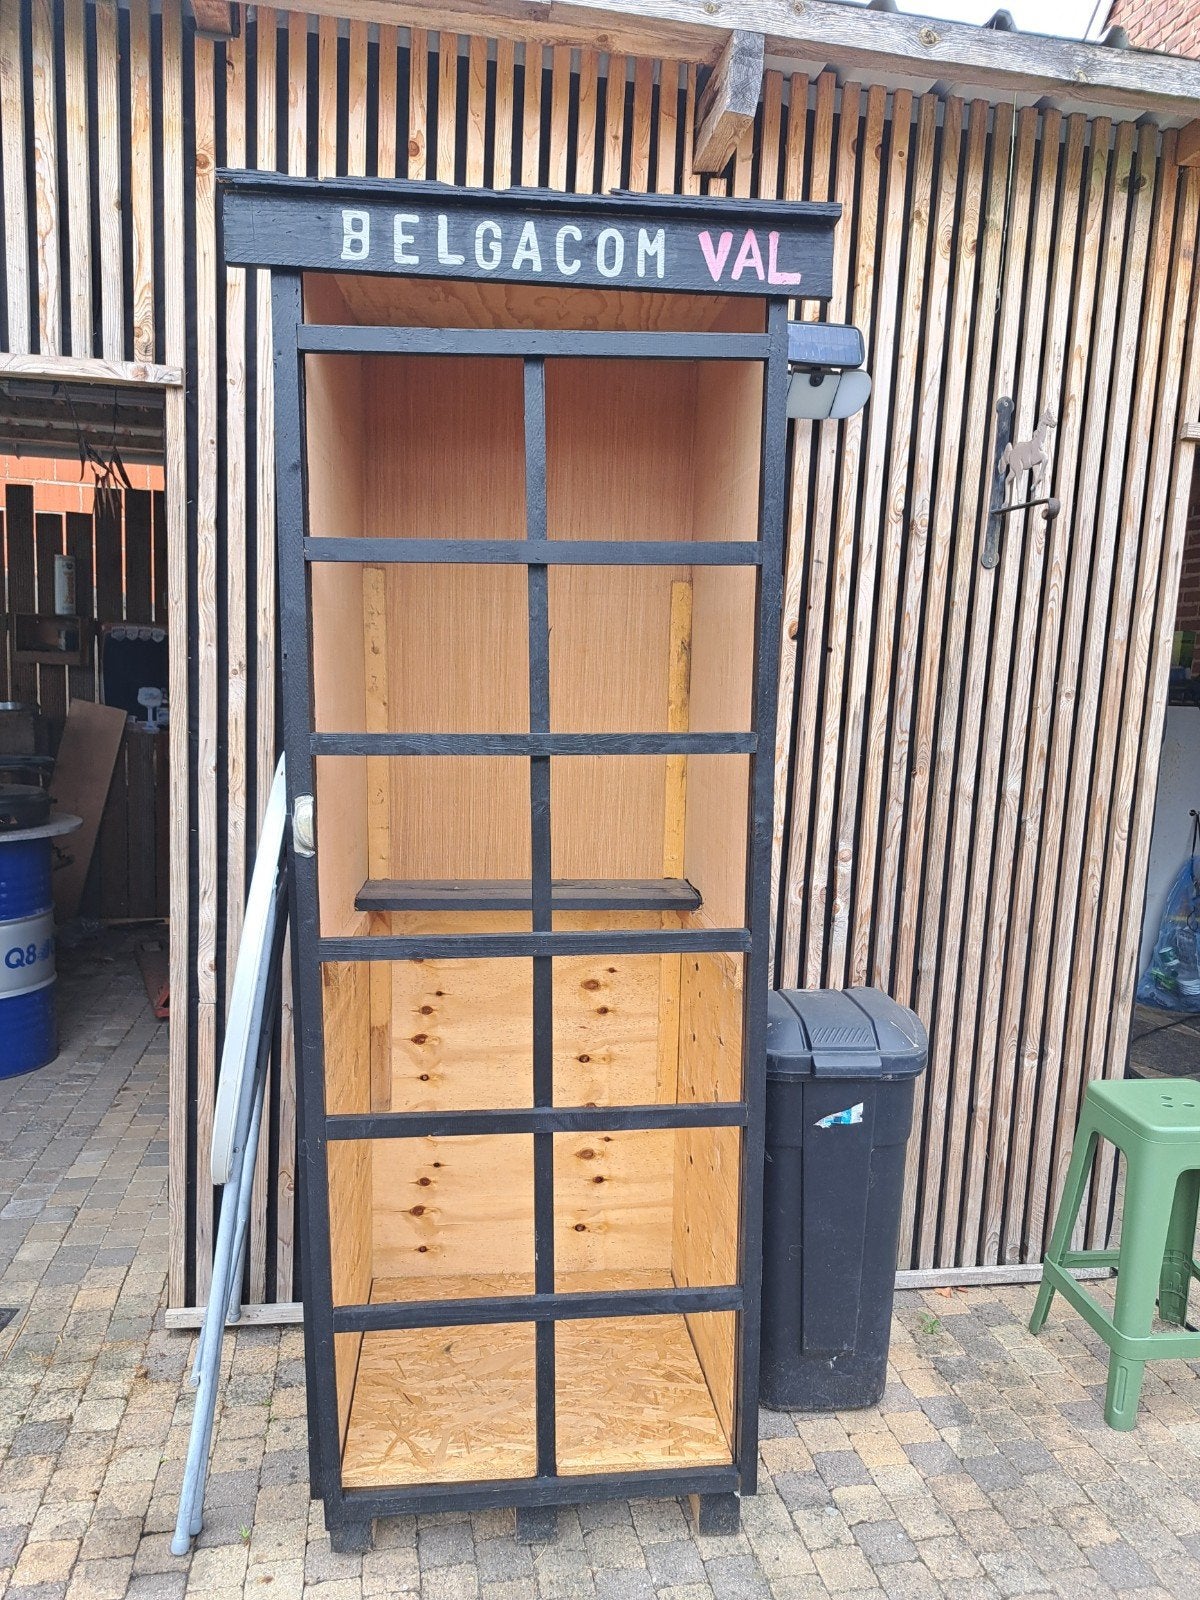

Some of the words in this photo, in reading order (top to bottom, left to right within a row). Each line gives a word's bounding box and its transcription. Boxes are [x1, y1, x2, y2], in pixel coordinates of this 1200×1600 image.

[340, 209, 666, 279] BELGACOM
[697, 228, 802, 285] VAL
[4, 943, 37, 969] Q8
